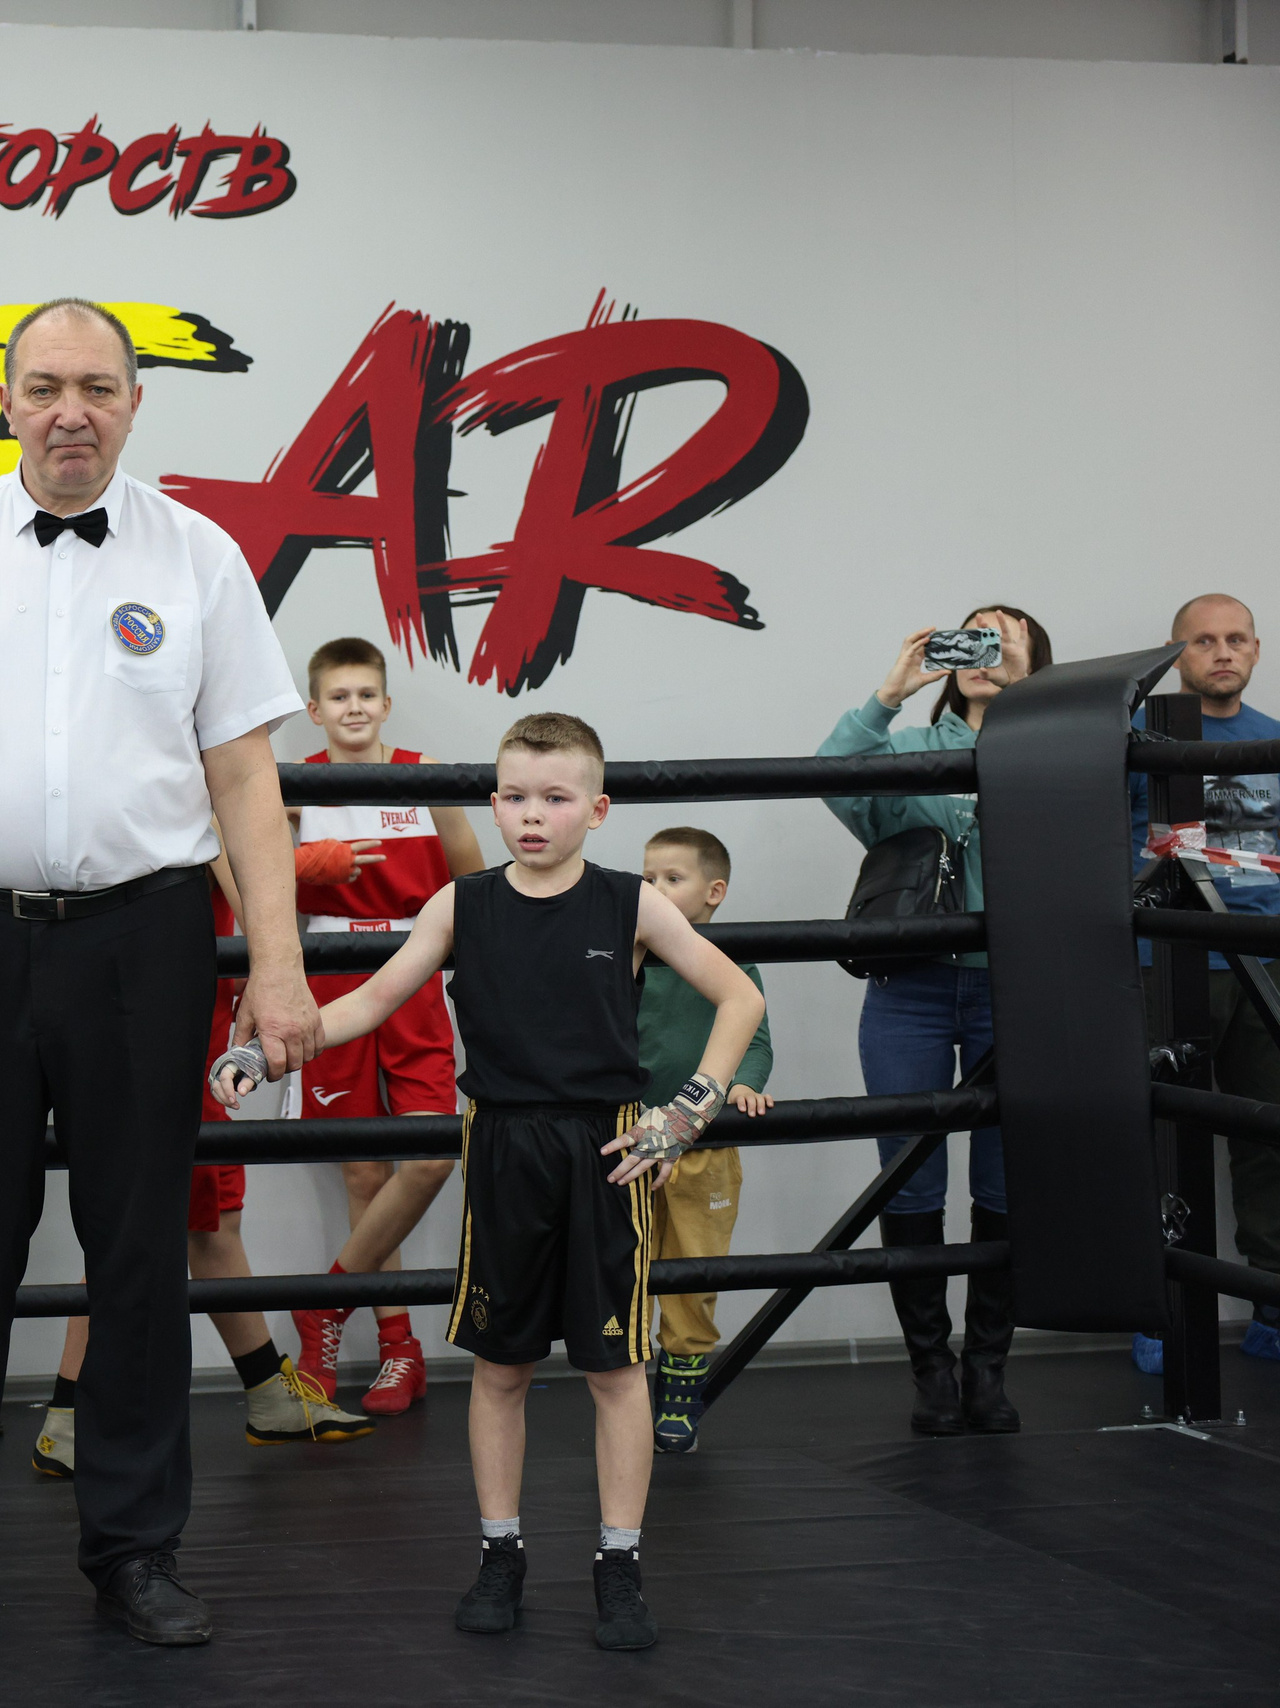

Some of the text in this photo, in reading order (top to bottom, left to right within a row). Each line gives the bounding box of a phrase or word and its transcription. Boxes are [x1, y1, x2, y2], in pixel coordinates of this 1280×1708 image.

[124, 614, 150, 643] РОССИЯ
[380, 806, 419, 828] EVERLAST
[602, 1328, 624, 1336] adidas
